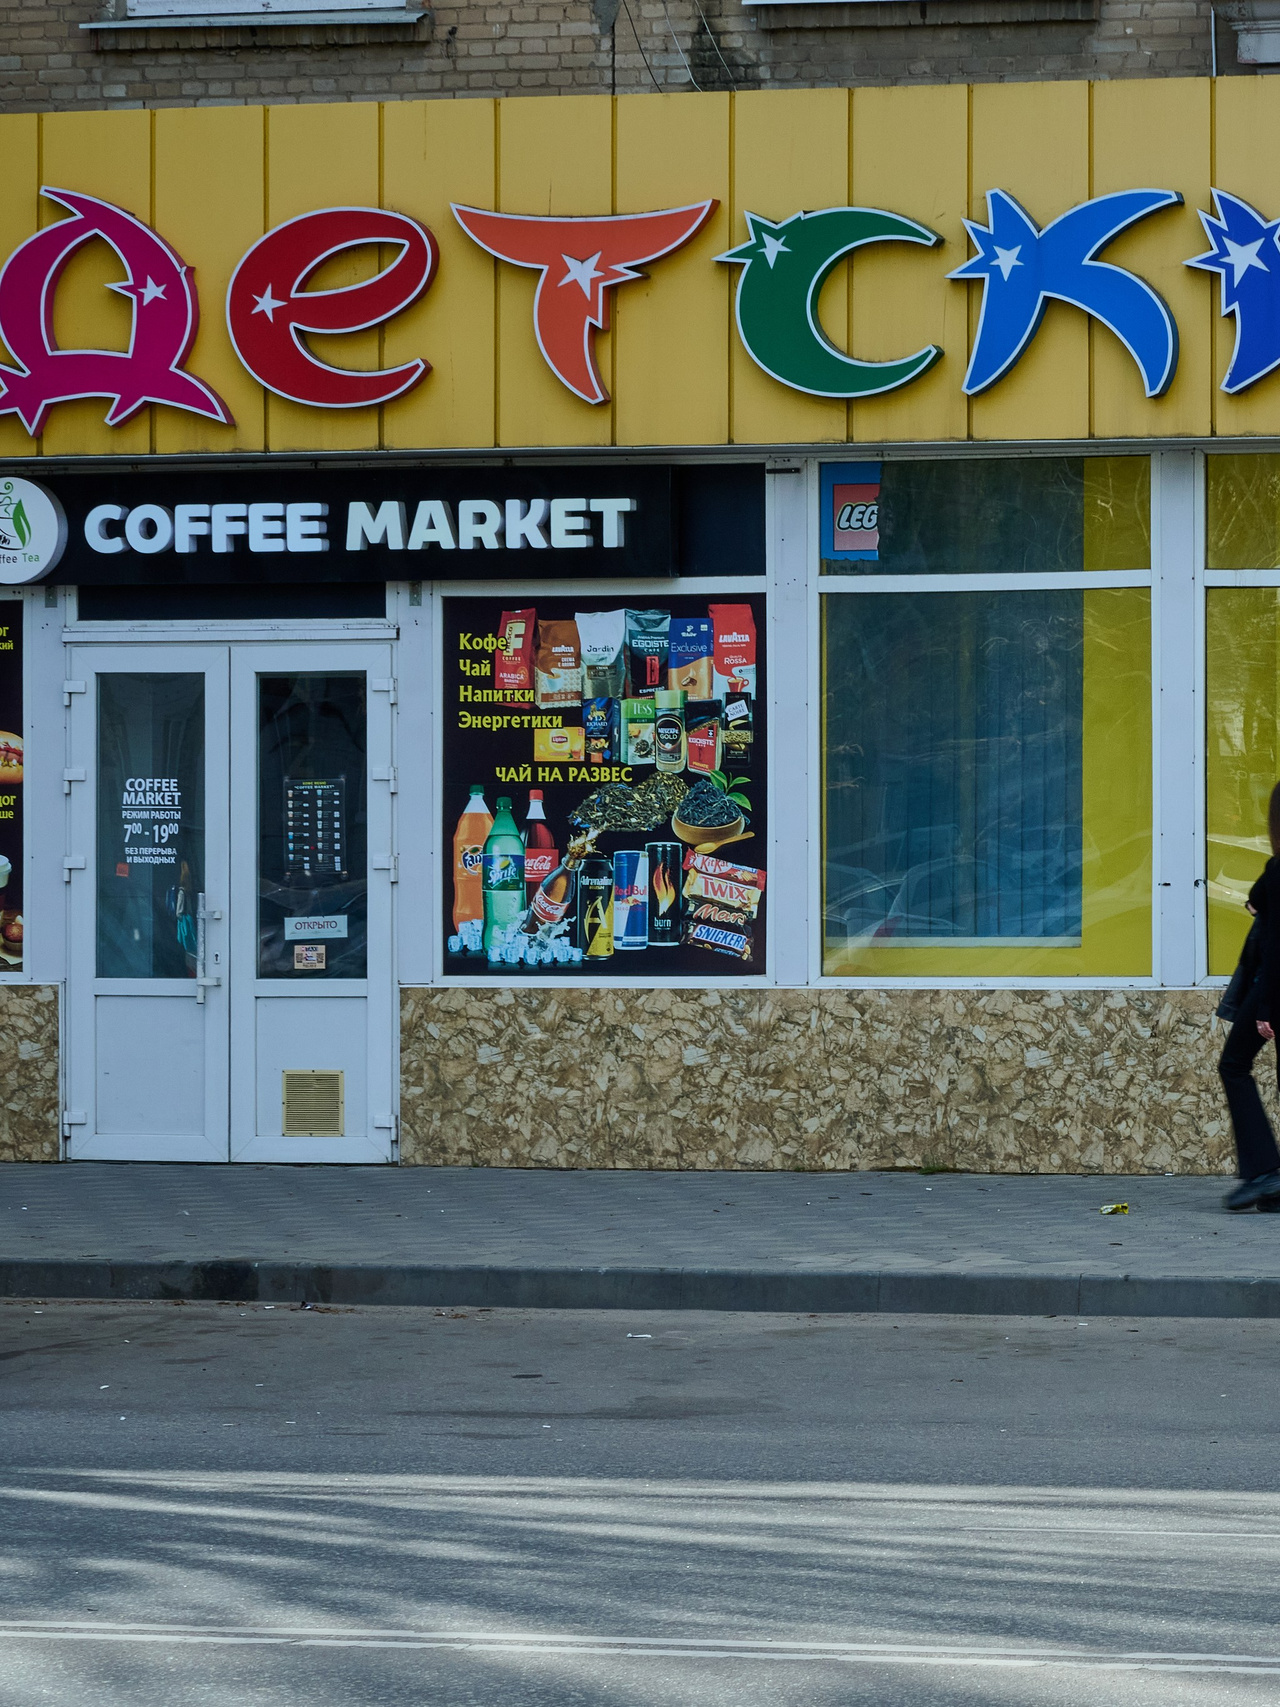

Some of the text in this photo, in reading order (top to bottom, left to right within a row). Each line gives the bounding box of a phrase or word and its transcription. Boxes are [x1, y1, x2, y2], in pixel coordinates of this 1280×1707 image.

[84, 498, 637, 554] COFFEE MARKET
[22, 553, 40, 563] Tea
[459, 633, 507, 653] Кофе
[587, 645, 614, 653] Jardin
[632, 639, 670, 648] EGOISTE
[670, 642, 708, 653] Exclusive
[459, 659, 491, 676] Чай
[459, 685, 534, 702] Напитки
[633, 702, 653, 715] TESS
[458, 711, 562, 731] Энергетики
[495, 764, 633, 782] ЧАЙ НА РАЗВЕС
[125, 778, 178, 791] COFFEE
[122, 791, 181, 805] MARKET
[122, 811, 181, 820] РЕЖИМ РАБОТЫ
[125, 847, 177, 855] БЕЗ ПЕРЕРЫВА
[699, 855, 729, 873] KitKat
[487, 867, 517, 885] Sprite
[614, 885, 632, 896] Red
[693, 904, 747, 926] Mars
[295, 921, 337, 930] ОТКРЫТО
[654, 917, 671, 928] burn
[695, 925, 747, 950] SNICKERS
